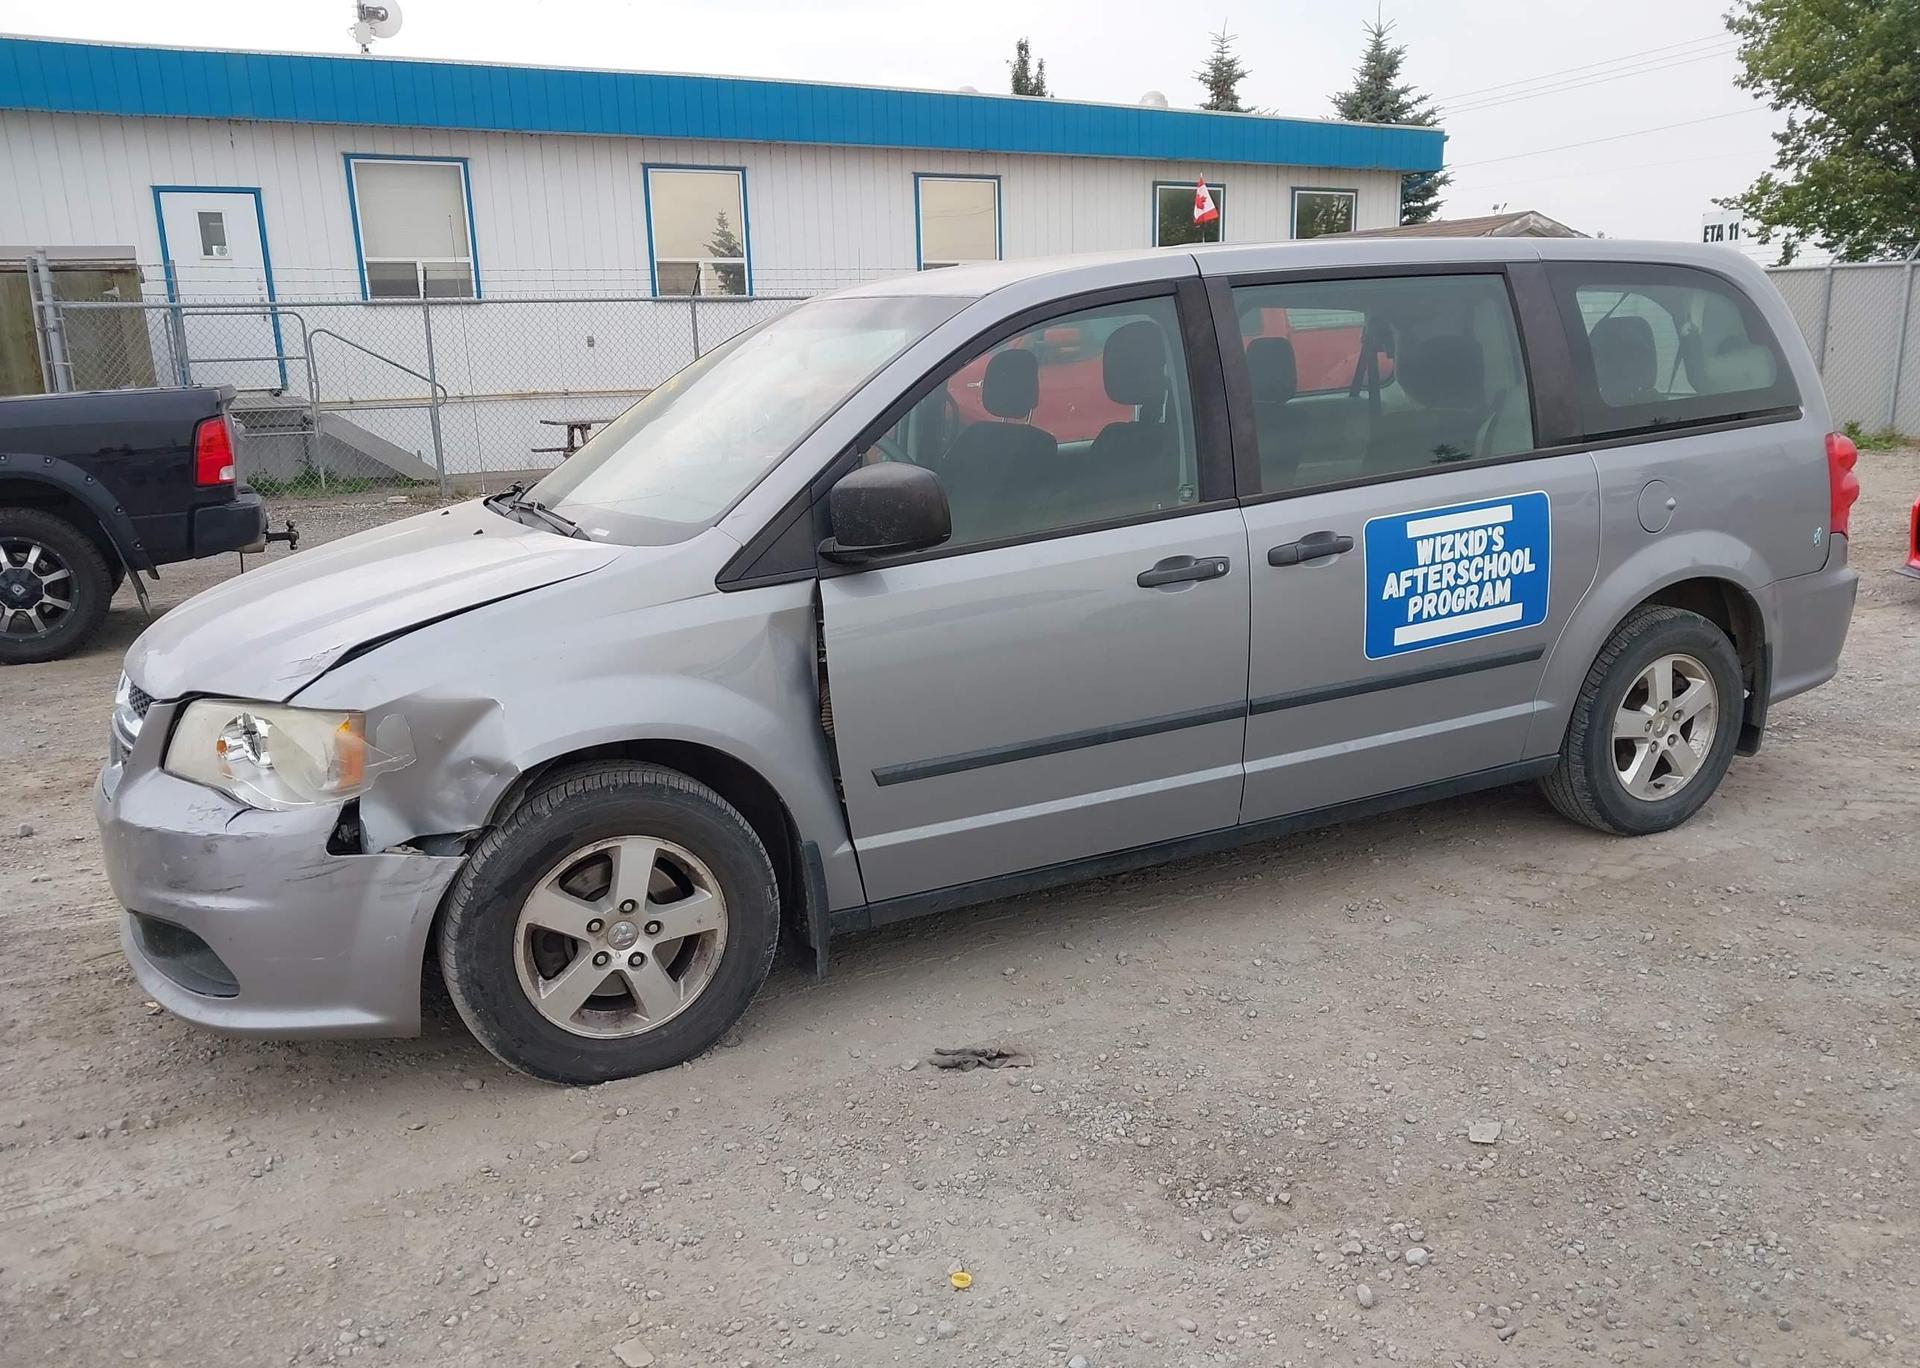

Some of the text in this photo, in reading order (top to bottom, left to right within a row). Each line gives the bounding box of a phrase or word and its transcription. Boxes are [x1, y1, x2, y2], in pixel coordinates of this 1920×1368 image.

[1703, 222, 1740, 243] ETA 11
[1416, 525, 1505, 565] WIZKID'S
[1382, 548, 1536, 600] AFTERSCHOOL
[1407, 578, 1511, 622] PROGRAM
